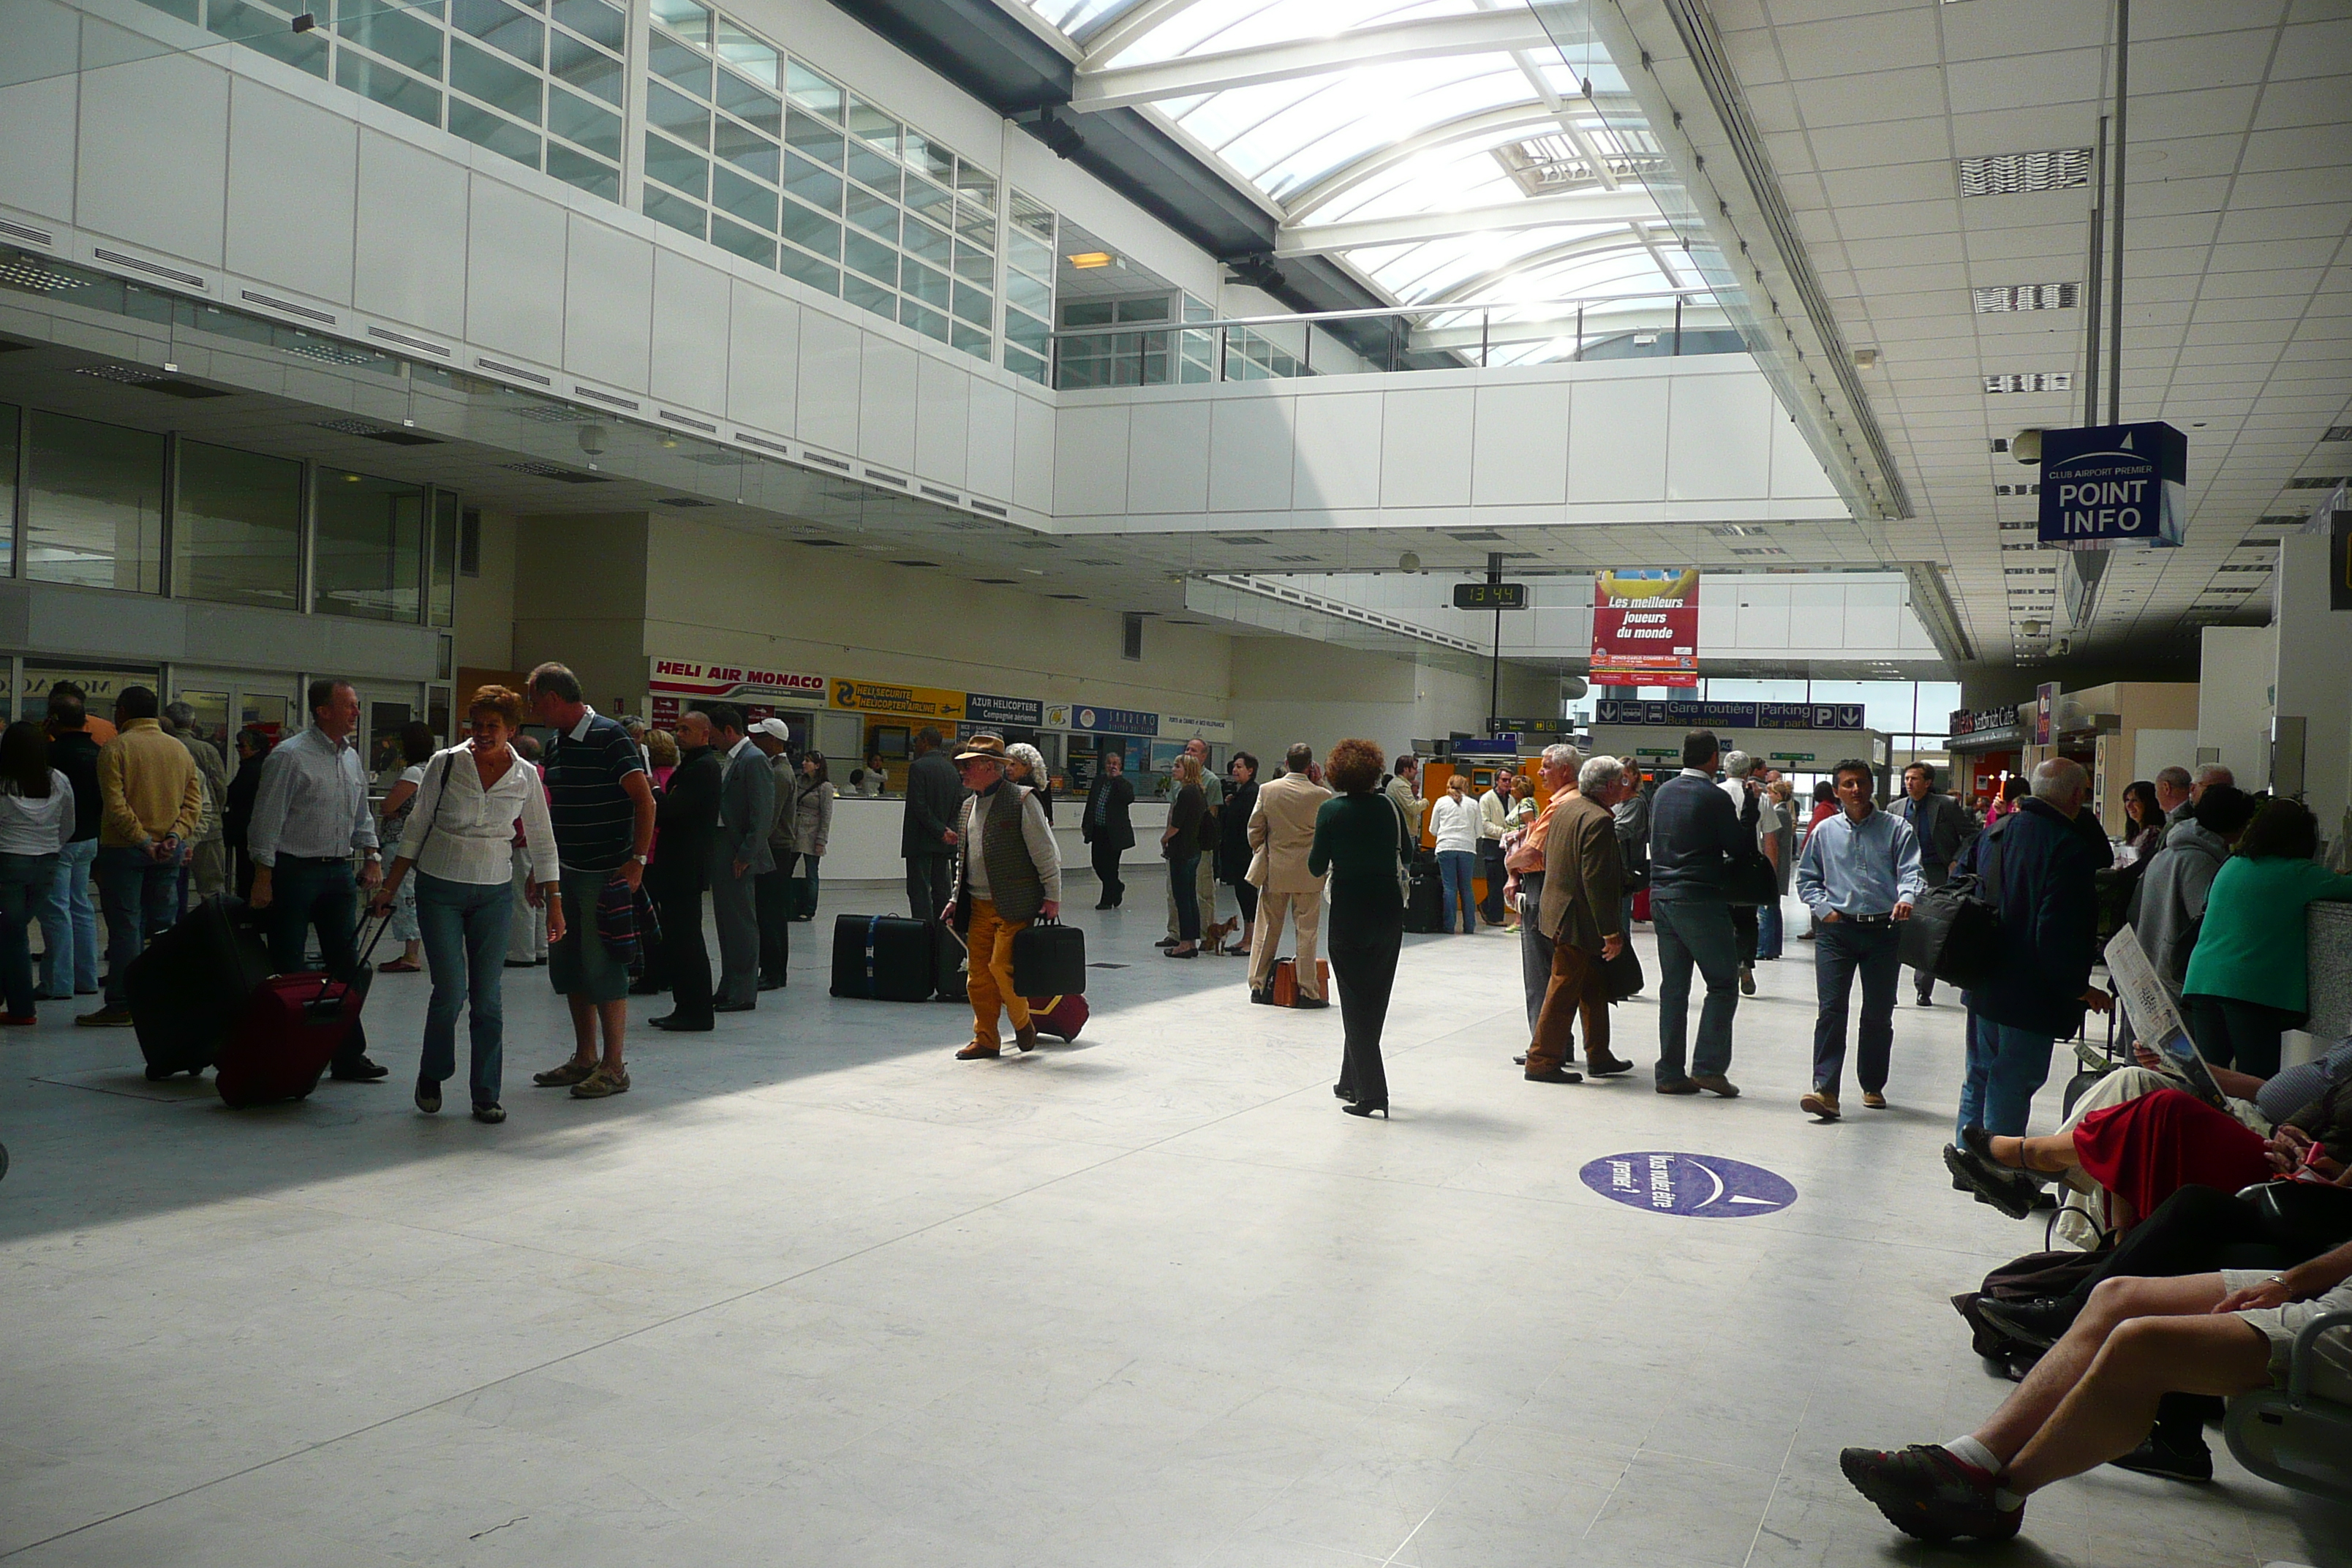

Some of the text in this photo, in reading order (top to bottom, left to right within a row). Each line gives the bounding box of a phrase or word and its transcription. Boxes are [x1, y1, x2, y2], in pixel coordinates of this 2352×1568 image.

[2048, 465, 2152, 480] CLUB AIRPORT PREMIER
[2059, 480, 2148, 508] POINT
[2063, 508, 2141, 534] INFO
[1609, 595, 1684, 608] Les meilleurs
[1623, 611, 1667, 625] joueurs
[1617, 626, 1673, 638] du monde
[655, 660, 823, 689] HELI AIR MONACO
[856, 685, 912, 699] HELI SECURITE
[860, 698, 935, 713] HELICOPTER AIRLINE
[971, 696, 1038, 712] AZUR HELICOPTERE
[1668, 701, 1754, 715] Gare routière
[1761, 703, 1811, 719] Parking
[983, 709, 1014, 722] Compagnie
[1667, 716, 1729, 726] Bus station
[1760, 717, 1809, 729] Car park
[1817, 707, 1833, 725] P
[1606, 1160, 1637, 1188] premier
[1648, 1155, 1677, 1207] Vous voulez être
